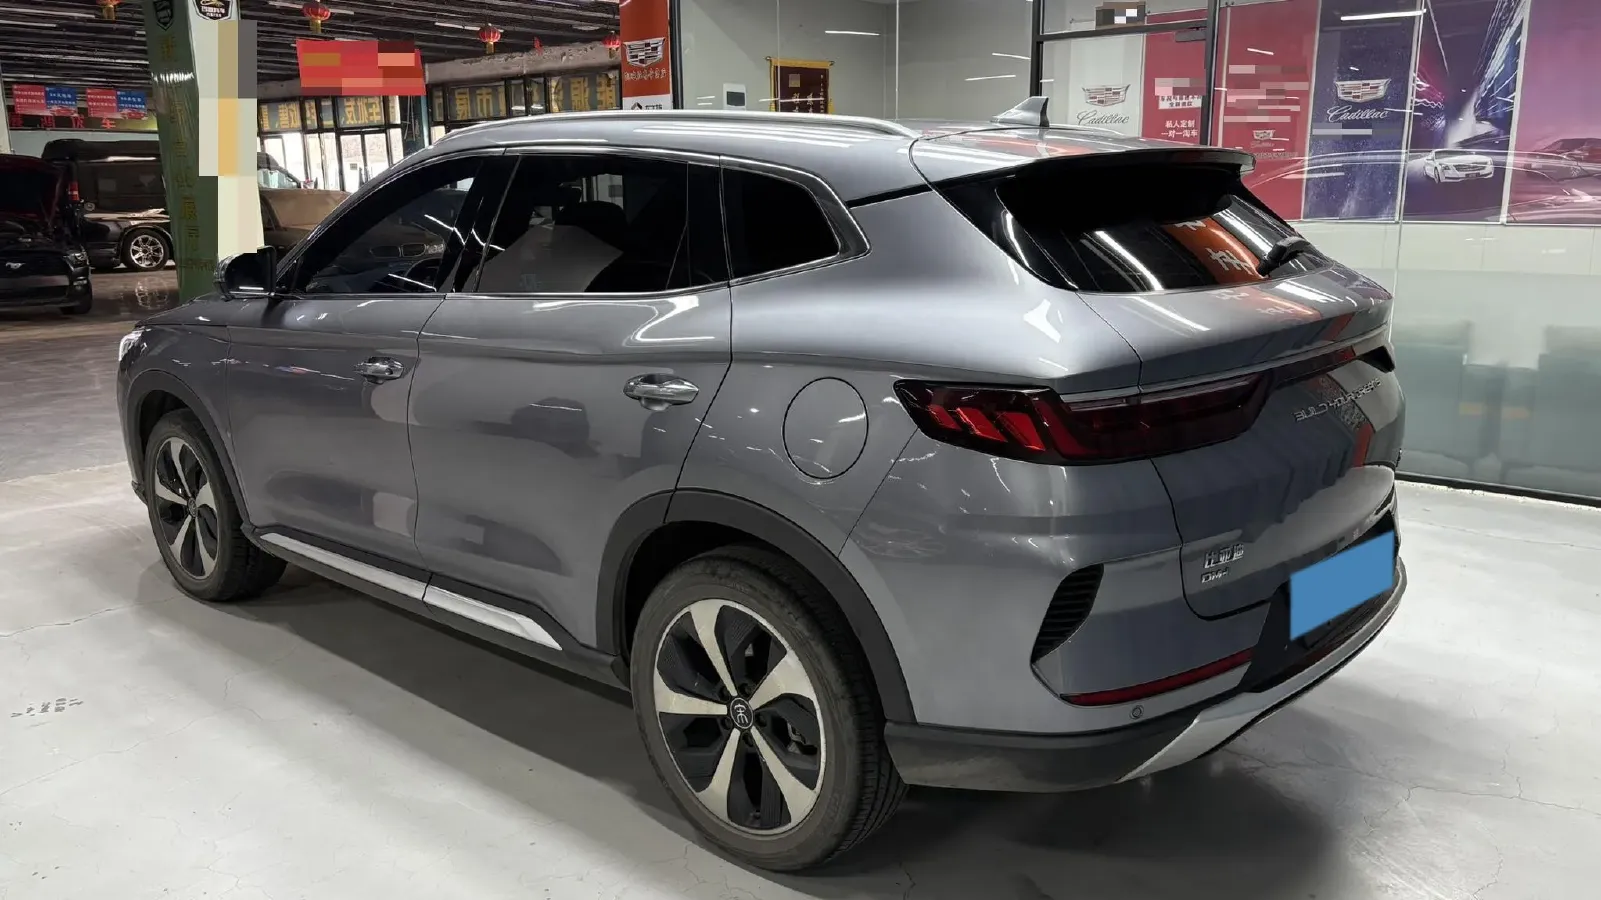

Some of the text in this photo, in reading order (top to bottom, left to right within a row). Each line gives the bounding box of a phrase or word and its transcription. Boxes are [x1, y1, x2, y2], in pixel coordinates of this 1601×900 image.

[1076, 109, 1130, 126] Cadillac
[1326, 105, 1390, 123] Cadillac
[1165, 119, 1195, 128] 私人定制
[1160, 129, 1198, 138] 一对一淘车
[1204, 544, 1244, 568] 比亚迪
